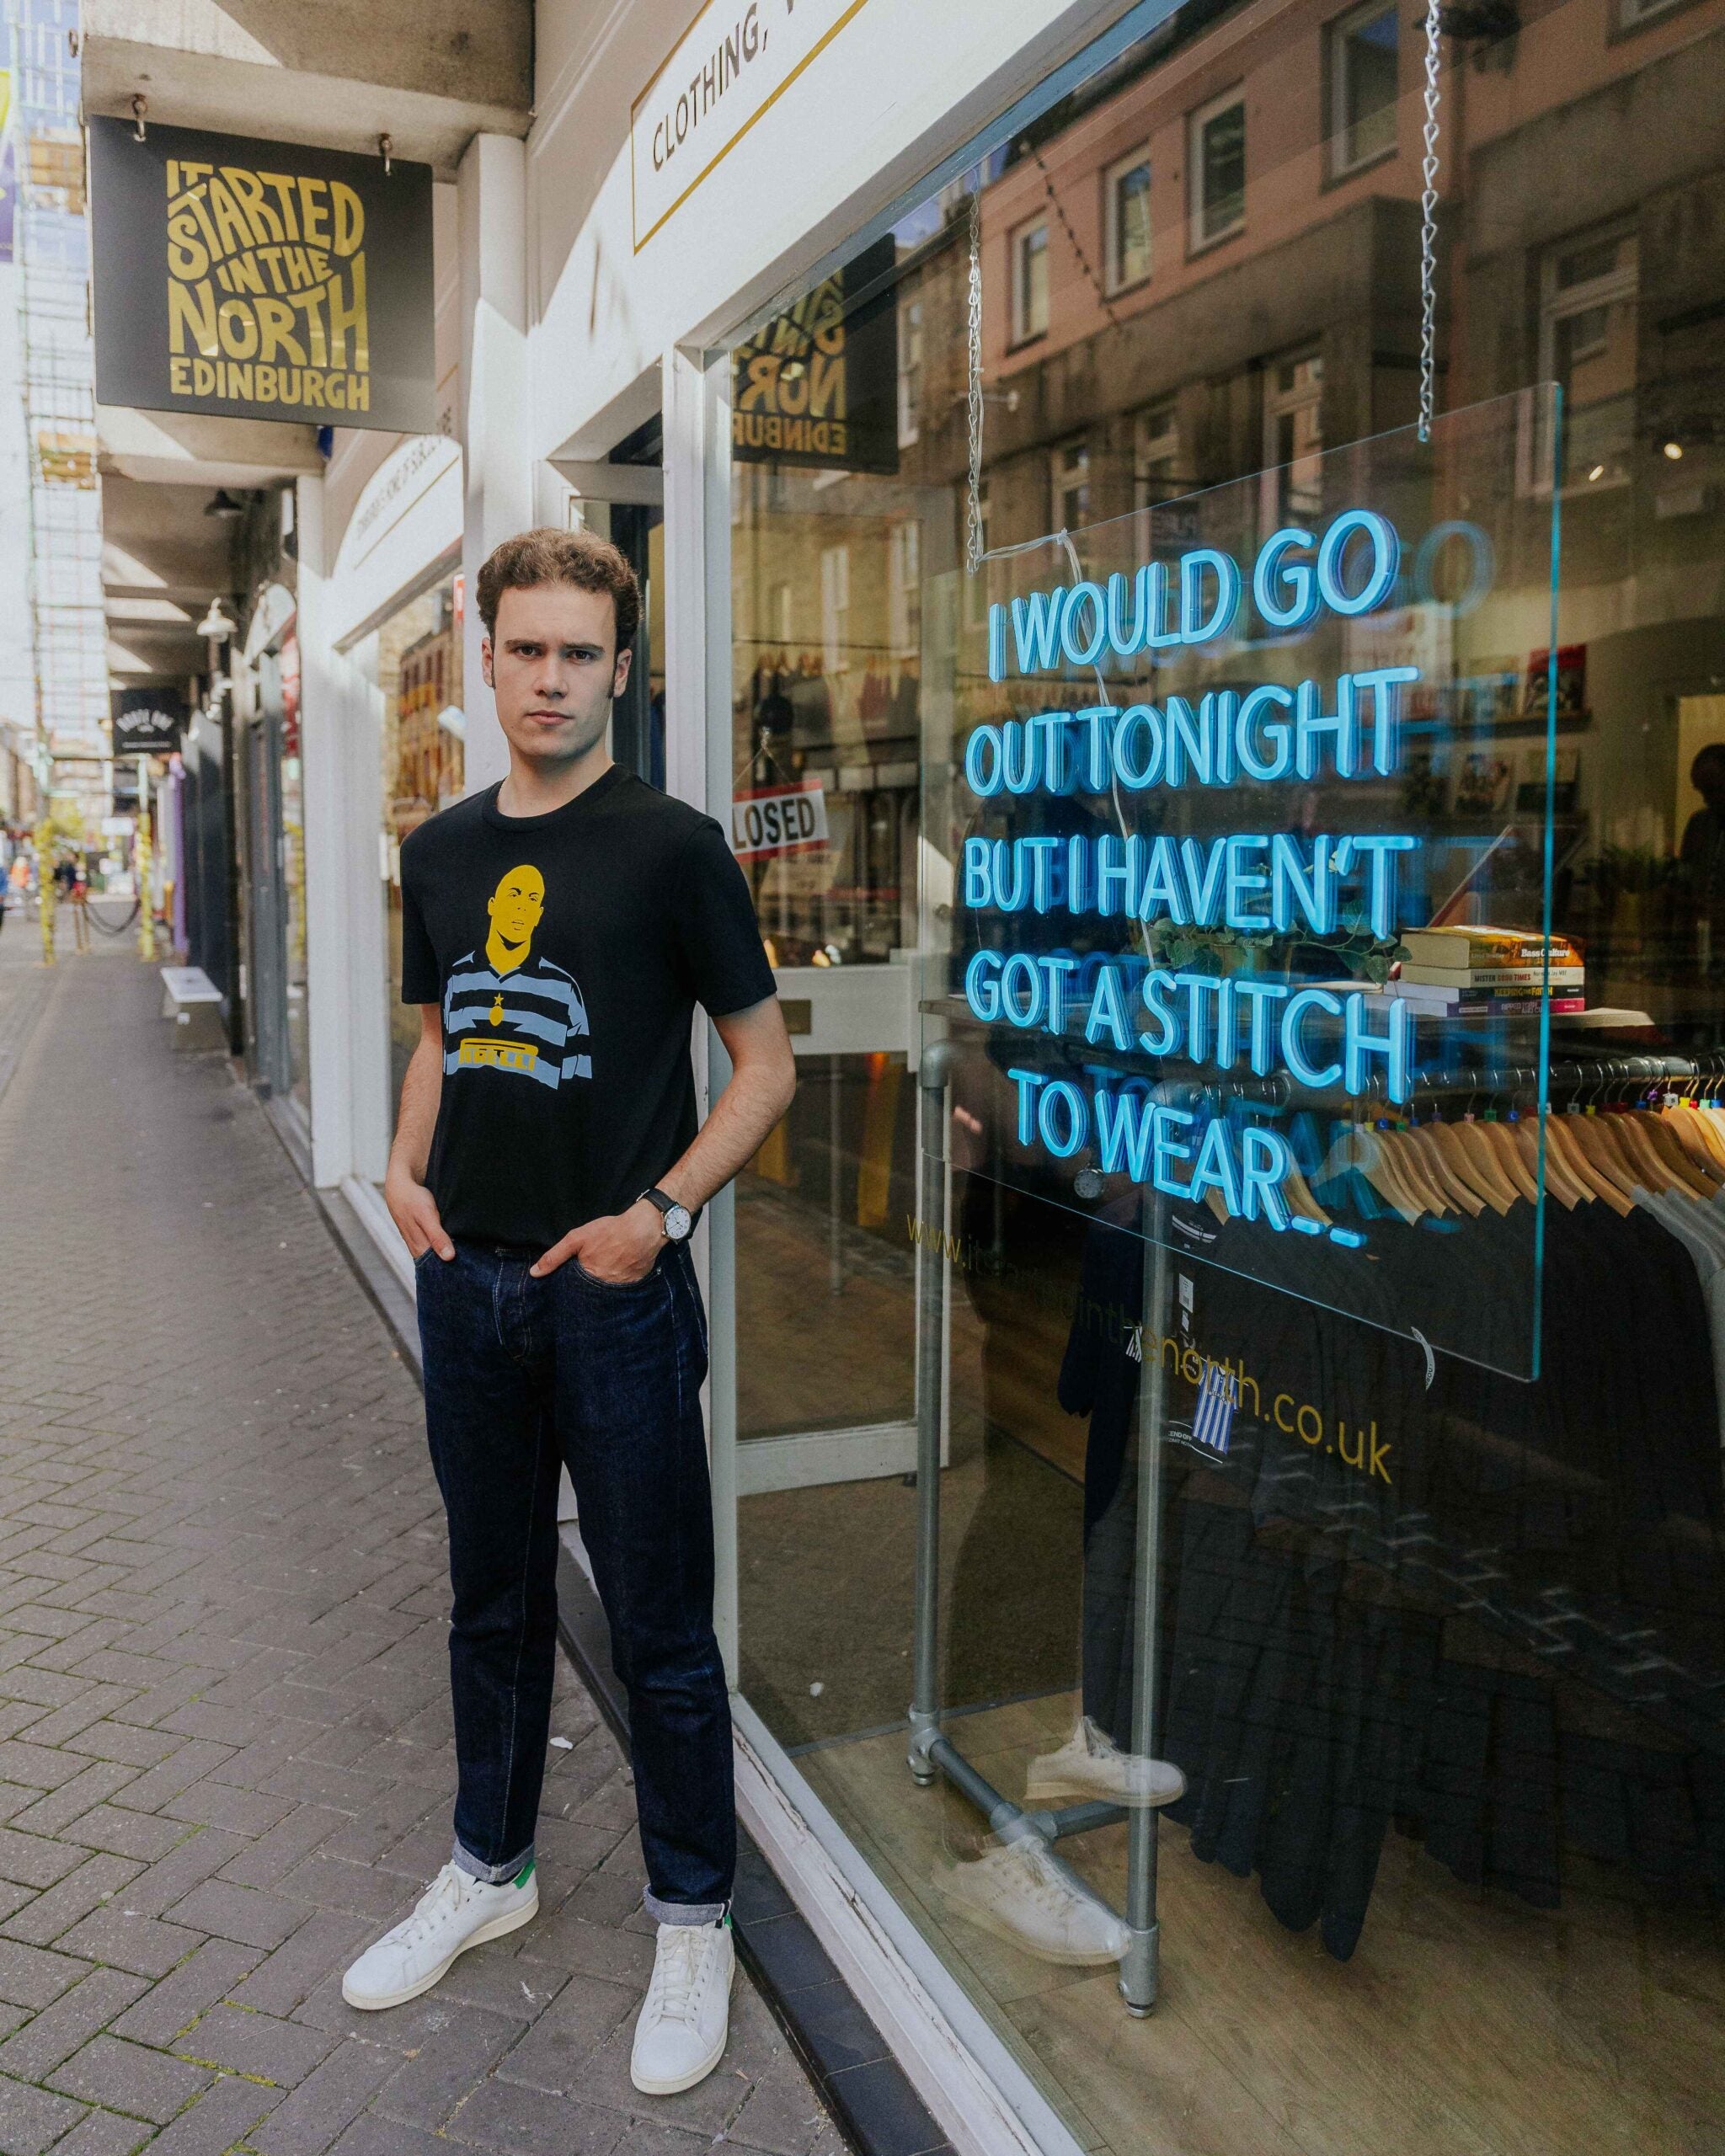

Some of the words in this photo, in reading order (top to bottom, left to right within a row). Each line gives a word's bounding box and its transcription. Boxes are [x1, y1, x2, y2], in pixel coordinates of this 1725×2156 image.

[654, 2, 768, 172] CLOTHING,
[166, 159, 213, 198] IT
[168, 166, 365, 280] STARTED
[168, 250, 369, 372] NORTH
[216, 251, 267, 294] IN
[256, 246, 334, 293] THE
[170, 356, 370, 411] EDINBURGH
[989, 603, 1007, 682] I
[1012, 548, 1241, 674] WOULD
[1253, 510, 1399, 627] GO
[965, 712, 1076, 797] OUT
[1076, 666, 1419, 790] TONIGHT
[732, 797, 815, 850] LOSED
[965, 835, 1059, 915] BUT
[1068, 834, 1087, 915] I
[1098, 834, 1420, 941] HAVEN'T
[1475, 974, 1496, 983] MISTER
[1514, 974, 1531, 982] TIMES
[1520, 948, 1540, 958] Bass
[1531, 986, 1553, 996] FAIH
[965, 950, 1080, 1035] GOT
[1086, 965, 1133, 1051] A
[1140, 969, 1413, 1104] STITCH
[1008, 1068, 1089, 1158] TO
